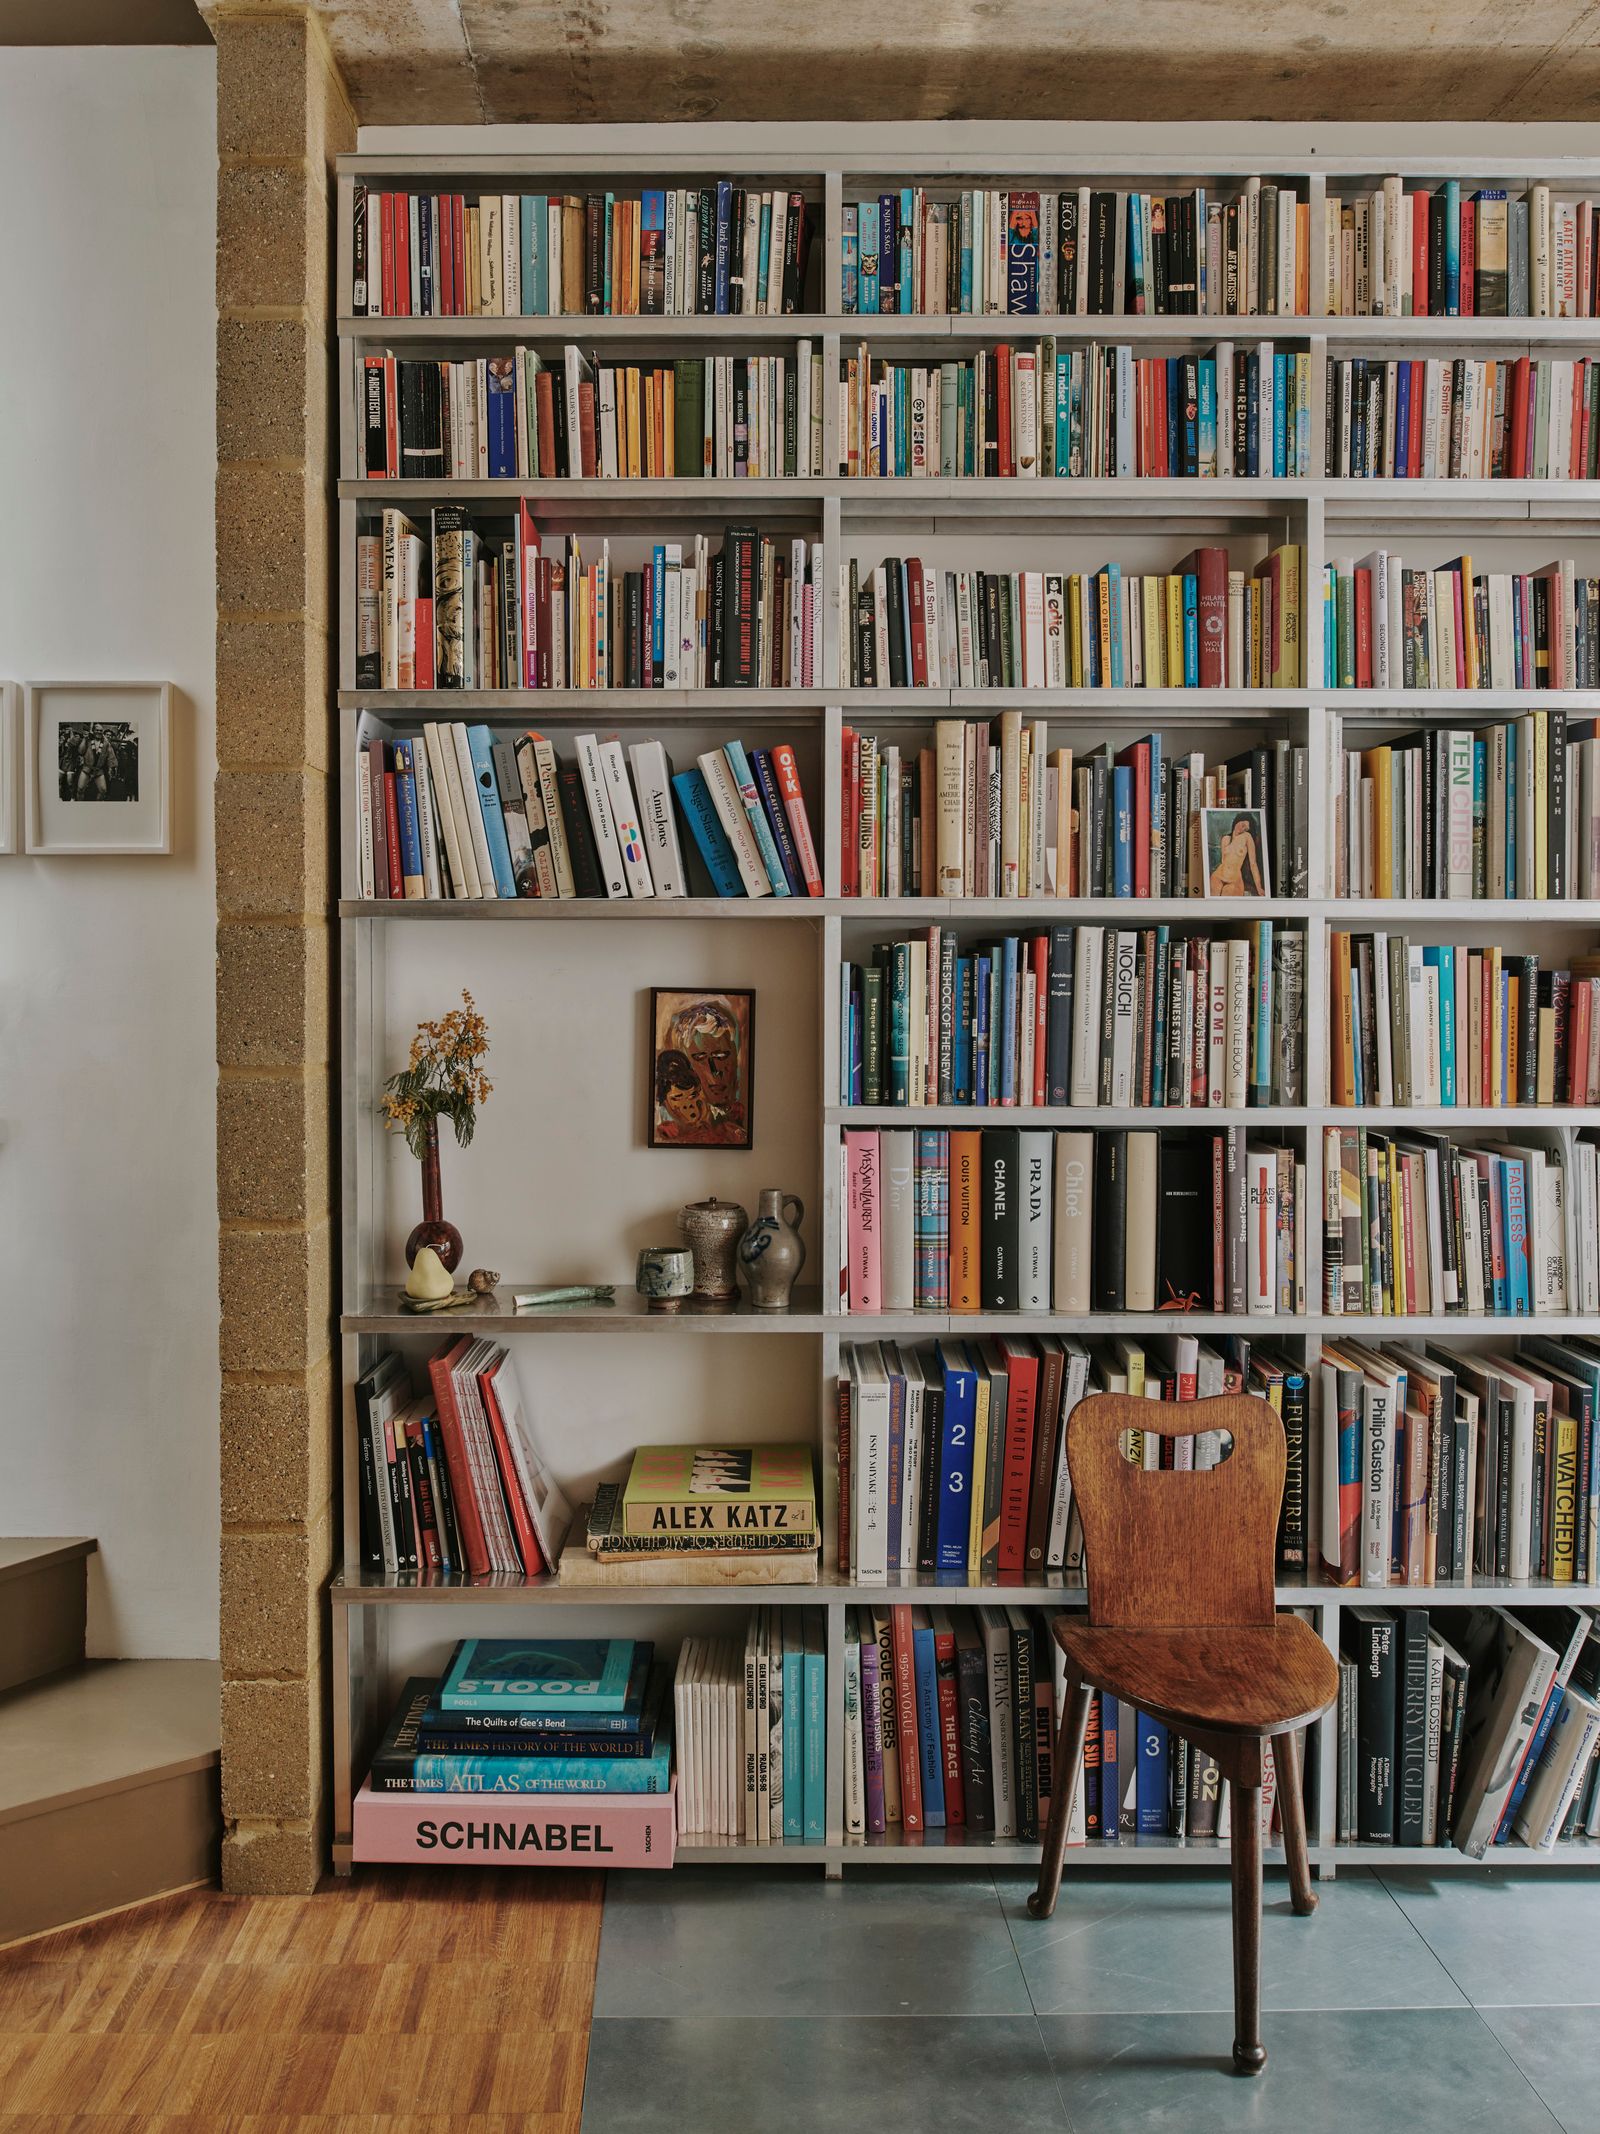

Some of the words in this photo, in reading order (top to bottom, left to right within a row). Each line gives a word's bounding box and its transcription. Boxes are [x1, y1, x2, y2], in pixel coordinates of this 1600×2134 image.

[1062, 201, 1073, 230] ECO
[720, 221, 728, 242] Dark
[1564, 220, 1573, 245] KATE
[719, 244, 727, 265] Emu
[1228, 250, 1236, 263] ART
[1011, 243, 1035, 315] Shaw
[1228, 272, 1237, 302] ARTISTS
[1564, 249, 1573, 299] ATKINSON
[1443, 369, 1452, 383] Ali
[369, 376, 381, 428] ARCHITECTURE
[1043, 372, 1054, 424] PARAPHERNALIA
[1238, 395, 1246, 420] RED
[1441, 385, 1450, 414] Smith
[1426, 418, 1436, 459] Pondlife
[814, 557, 821, 572] ON
[714, 599, 722, 607] by
[927, 596, 935, 625] Smith
[758, 754, 766, 769] THE
[1453, 735, 1470, 785] TEN
[540, 762, 556, 816] Persiana
[761, 770, 772, 792] RIVER
[652, 790, 665, 818] Anna
[689, 784, 707, 810] Nigel
[700, 814, 719, 845] Slater
[768, 794, 777, 810] CAFE
[655, 819, 669, 847] Jones
[774, 813, 785, 832] COOK
[1453, 791, 1469, 870] CITIES
[781, 835, 792, 855] BOOK
[942, 949, 951, 970] THE
[1107, 934, 1115, 1004] FORMAFANTASMA
[1235, 955, 1244, 973] THE
[942, 973, 951, 1012] SHOCK
[1118, 945, 1134, 1016] NOGUCHI
[1234, 976, 1243, 1012] HOUSE
[1528, 966, 1537, 1009] Rewilding
[1172, 978, 1181, 1025] JAPANESE
[1214, 986, 1223, 1045] HOME
[942, 1013, 950, 1027] OF
[1233, 1014, 1243, 1045] STYLE
[942, 1030, 950, 1049] THE
[1171, 1027, 1180, 1058] STYLE
[941, 1052, 950, 1079] NEW
[1233, 1048, 1242, 1078] BOOK
[1228, 1126, 1236, 1144] Willi
[921, 1167, 931, 1216] Westwood
[932, 1170, 941, 1210] Vivienne
[995, 1160, 1005, 1220] CHANEL
[1030, 1158, 1041, 1222] PRADA
[1066, 1160, 1084, 1217] Chloé
[1508, 1167, 1522, 1242] FACELESS
[956, 1377, 965, 1398] 1
[1012, 1389, 1029, 1461] YAMAMOTO
[1370, 1398, 1386, 1438] Philip
[869, 1435, 877, 1459] ISSEY
[951, 1424, 966, 1446] 2
[1442, 1433, 1450, 1453] Alina
[1286, 1405, 1302, 1532] FURNITURE
[1370, 1439, 1386, 1492] Guston
[949, 1471, 964, 1493] 3
[1441, 1455, 1450, 1510] Szapocznikow
[653, 1507, 714, 1529] ALEX
[727, 1505, 788, 1528] KATZ
[1008, 1489, 1022, 1528] YOHJI
[1557, 1451, 1575, 1562] WATCHED!
[879, 1625, 892, 1682] VOGUE
[1370, 1627, 1381, 1678] Lindbergh
[1381, 1627, 1390, 1655] Peter
[900, 1652, 908, 1680] 1950s
[994, 1652, 1009, 1708] BETAK
[1018, 1635, 1029, 1704] ANOTHER
[1407, 1633, 1426, 1727] THIERRY
[1431, 1658, 1441, 1690] KARL
[457, 1681, 598, 1694] POOLS
[849, 1671, 857, 1720] STYLISTS
[902, 1683, 909, 1691] in
[466, 1718, 481, 1726] The
[483, 1718, 507, 1728] Quilts
[510, 1718, 518, 1727] of
[520, 1719, 543, 1728] Gee's
[545, 1719, 565, 1728] Bend
[882, 1687, 896, 1749] COVERS
[902, 1691, 913, 1736] VOGUE
[946, 1715, 955, 1741] THE
[964, 1697, 989, 1752] Clothing
[1020, 1708, 1031, 1740] MAN
[1428, 1695, 1439, 1763] BLOSSFELDT
[947, 1744, 957, 1778] FACE
[971, 1758, 985, 1784] Art
[385, 1779, 407, 1787] THE
[408, 1779, 443, 1788] TIMES
[448, 1775, 520, 1792] ATLAS
[525, 1780, 538, 1789] OF
[538, 1780, 559, 1789] THE
[559, 1780, 606, 1789] WORLD
[1404, 1733, 1423, 1824] MUGLER
[416, 1821, 613, 1852] SCHNABEL
